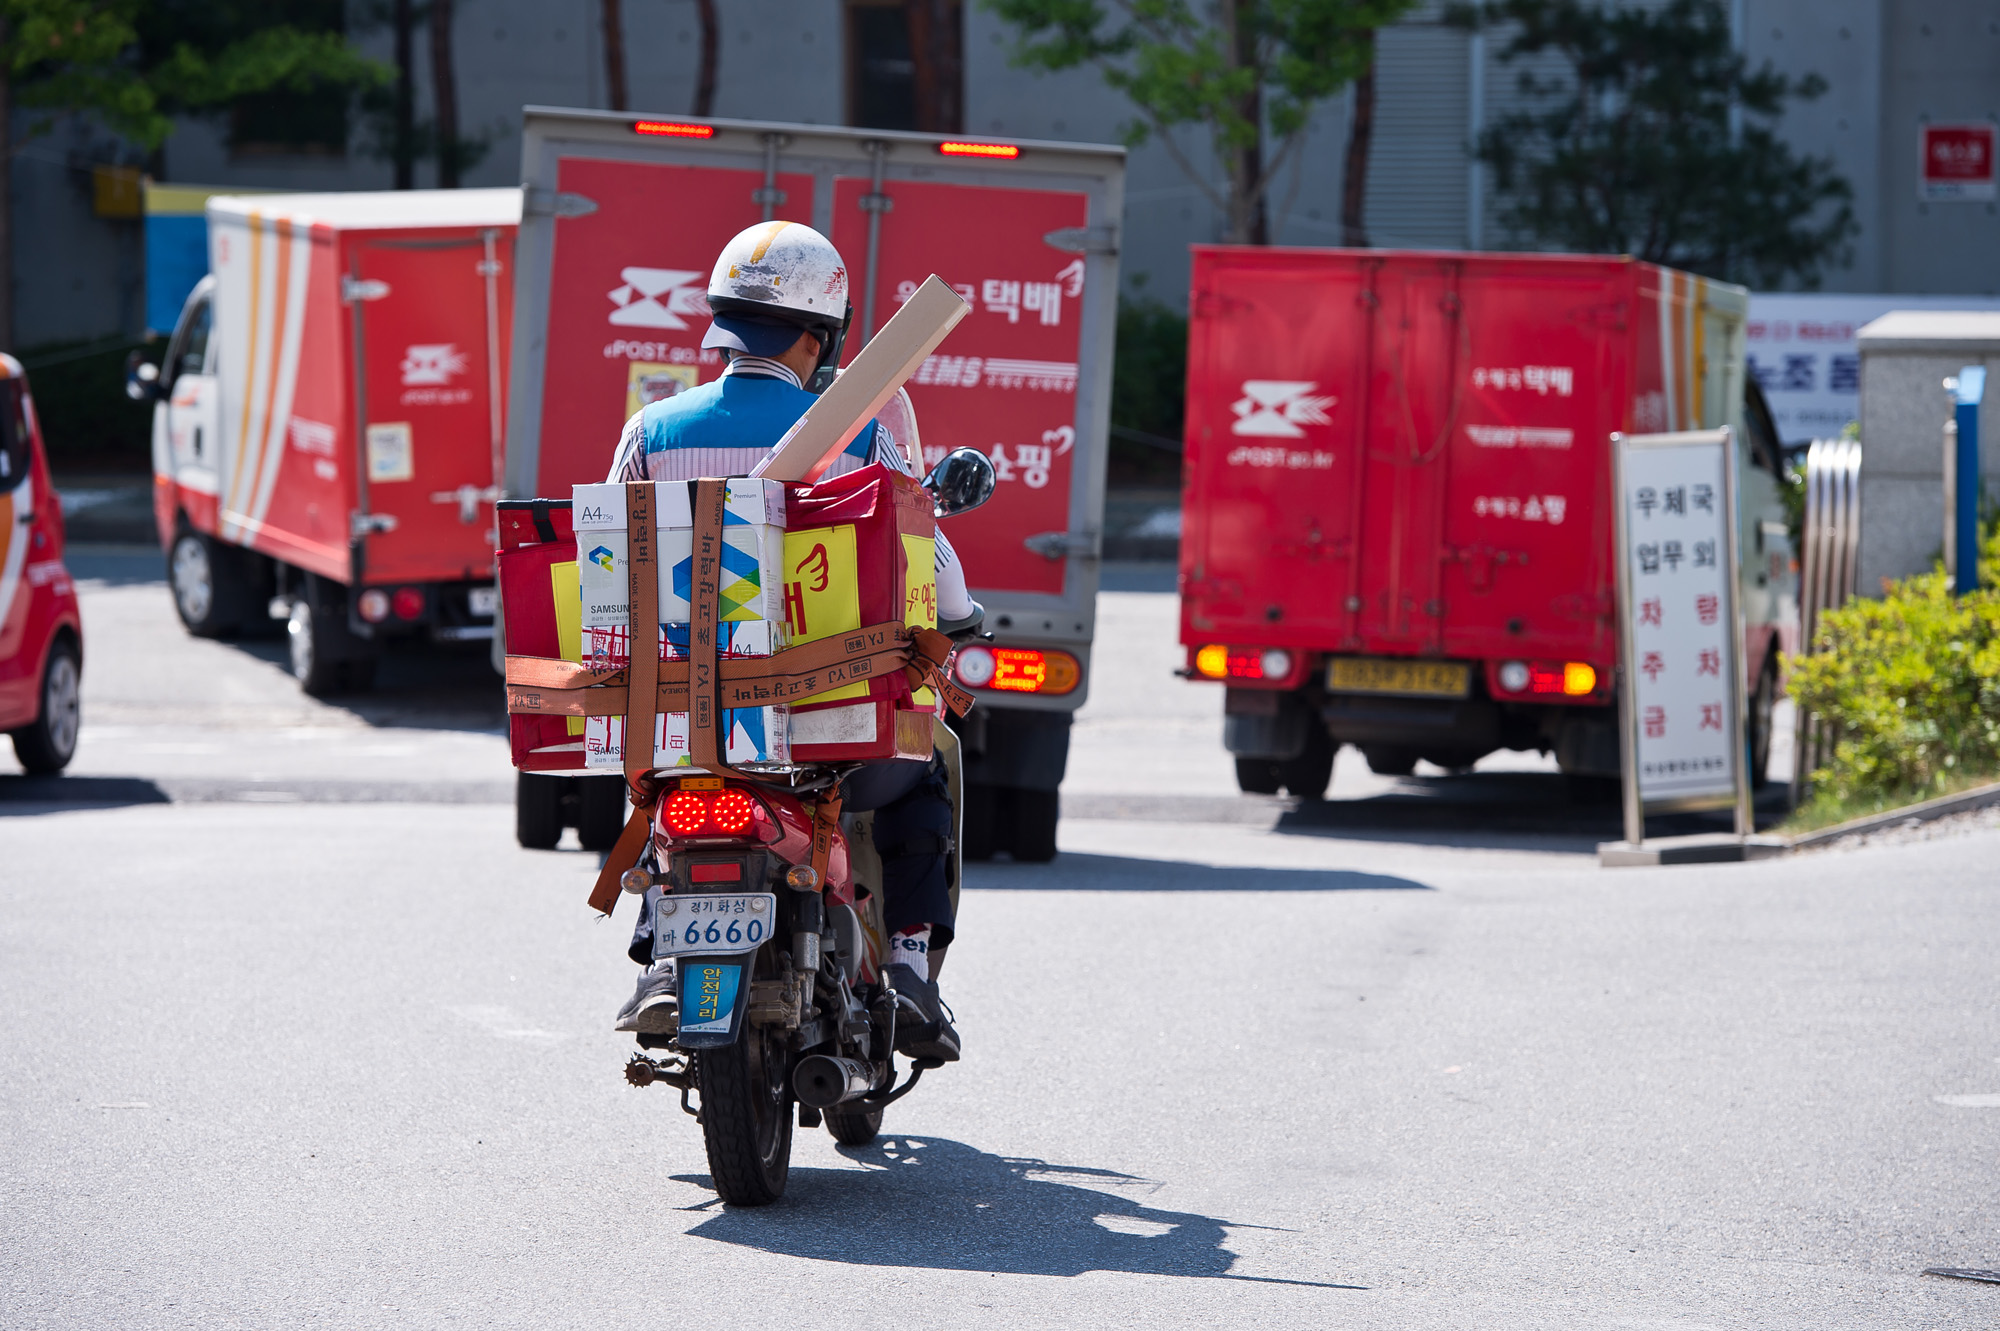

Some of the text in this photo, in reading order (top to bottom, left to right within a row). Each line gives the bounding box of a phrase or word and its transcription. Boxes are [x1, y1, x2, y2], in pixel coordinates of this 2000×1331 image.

[915, 354, 984, 388] EMS
[582, 507, 602, 520] A4
[1635, 484, 1717, 519] 우체국
[632, 485, 649, 566] 고강력바
[698, 532, 716, 646] 초고강력바
[590, 604, 629, 614] SAMSUN
[632, 601, 639, 611] IN
[868, 632, 885, 646] YJ
[698, 664, 709, 689] YJ
[732, 675, 817, 701] 초고강력바
[828, 667, 847, 684] YJ
[661, 687, 689, 695] KOREA
[691, 899, 745, 914] 경기 화성
[662, 919, 763, 946] 마 6660
[698, 967, 723, 1020] 안전거리
